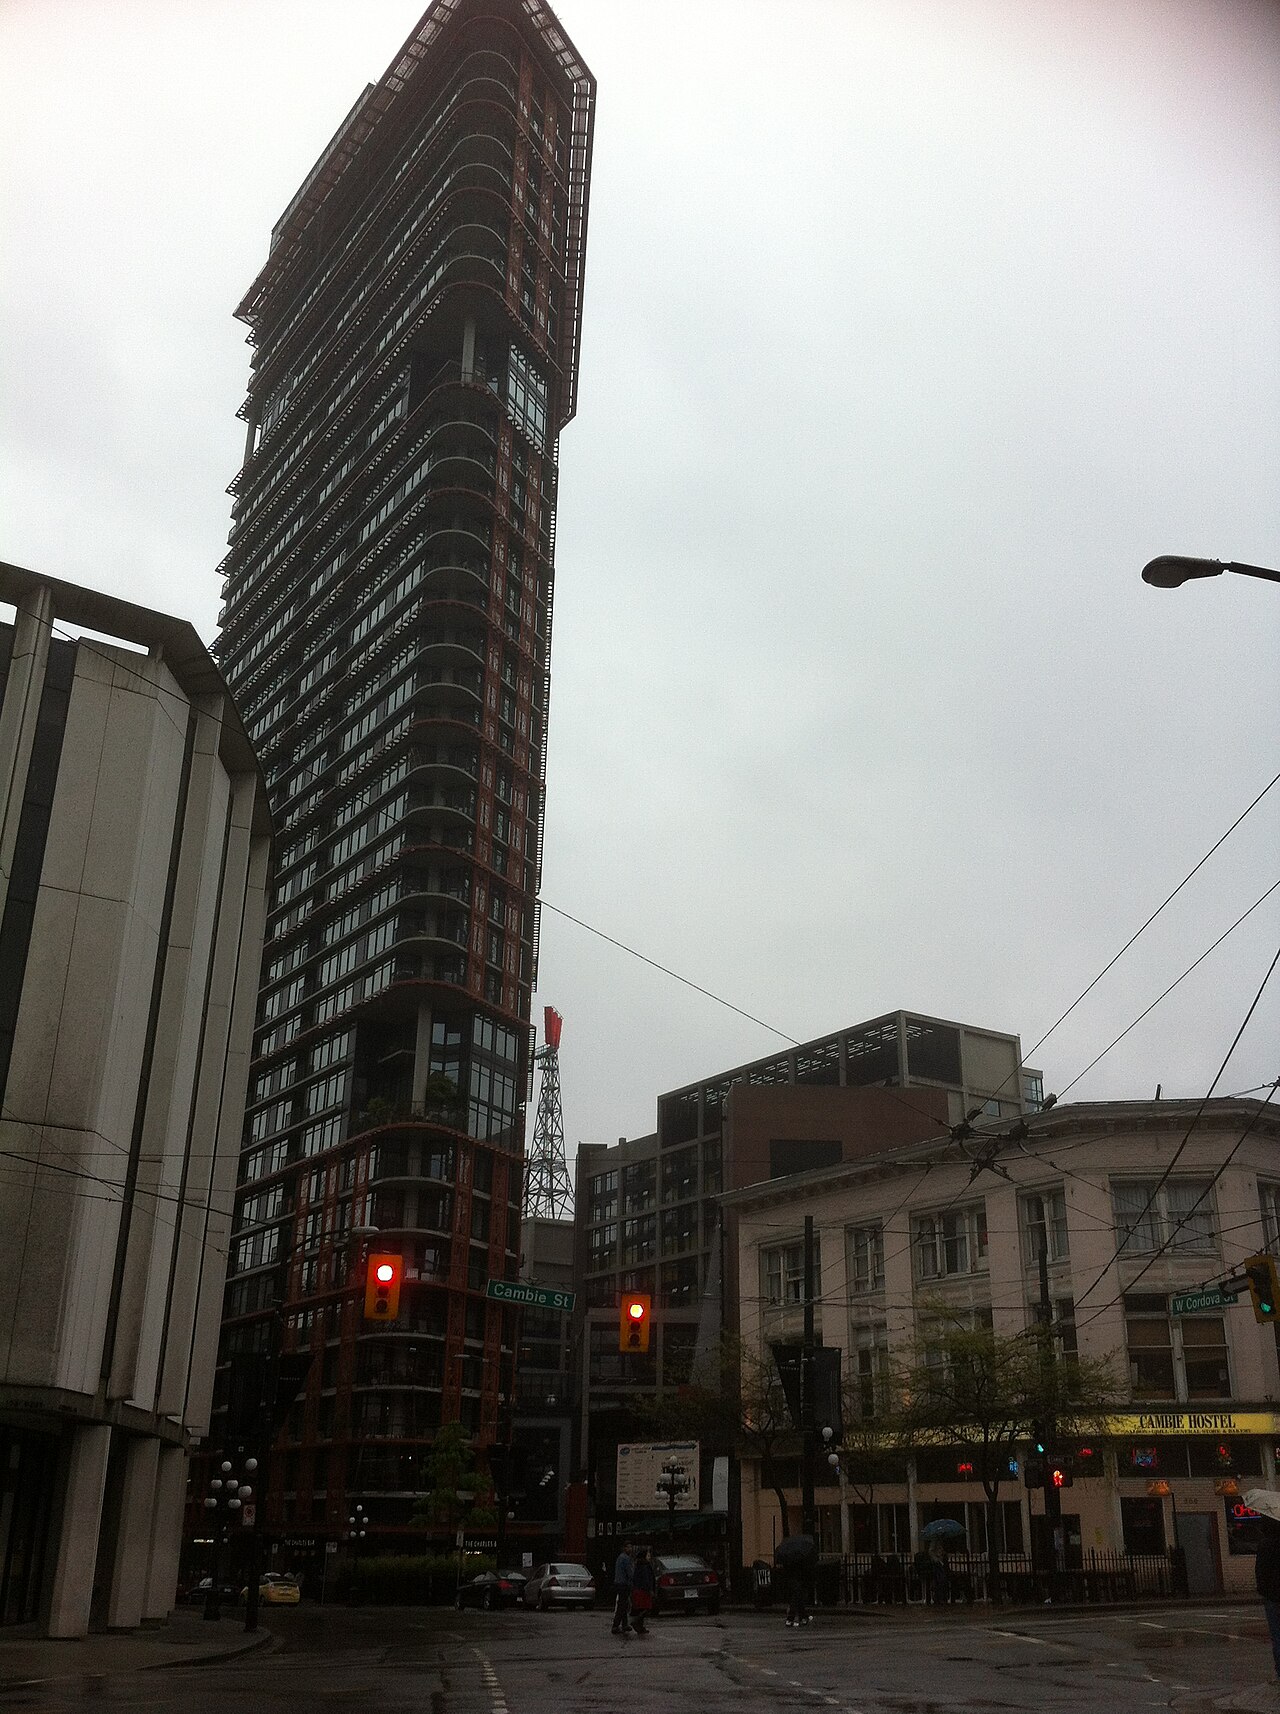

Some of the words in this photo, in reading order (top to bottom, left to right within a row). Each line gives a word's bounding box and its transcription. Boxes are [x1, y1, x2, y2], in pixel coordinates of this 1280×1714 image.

[494, 1283, 547, 1303] Cambie
[553, 1293, 569, 1307] St
[1176, 1300, 1184, 1311] W
[1186, 1294, 1221, 1310] Cordova
[1139, 1414, 1185, 1428] CAMBIE
[1188, 1414, 1236, 1428] HOSTEL
